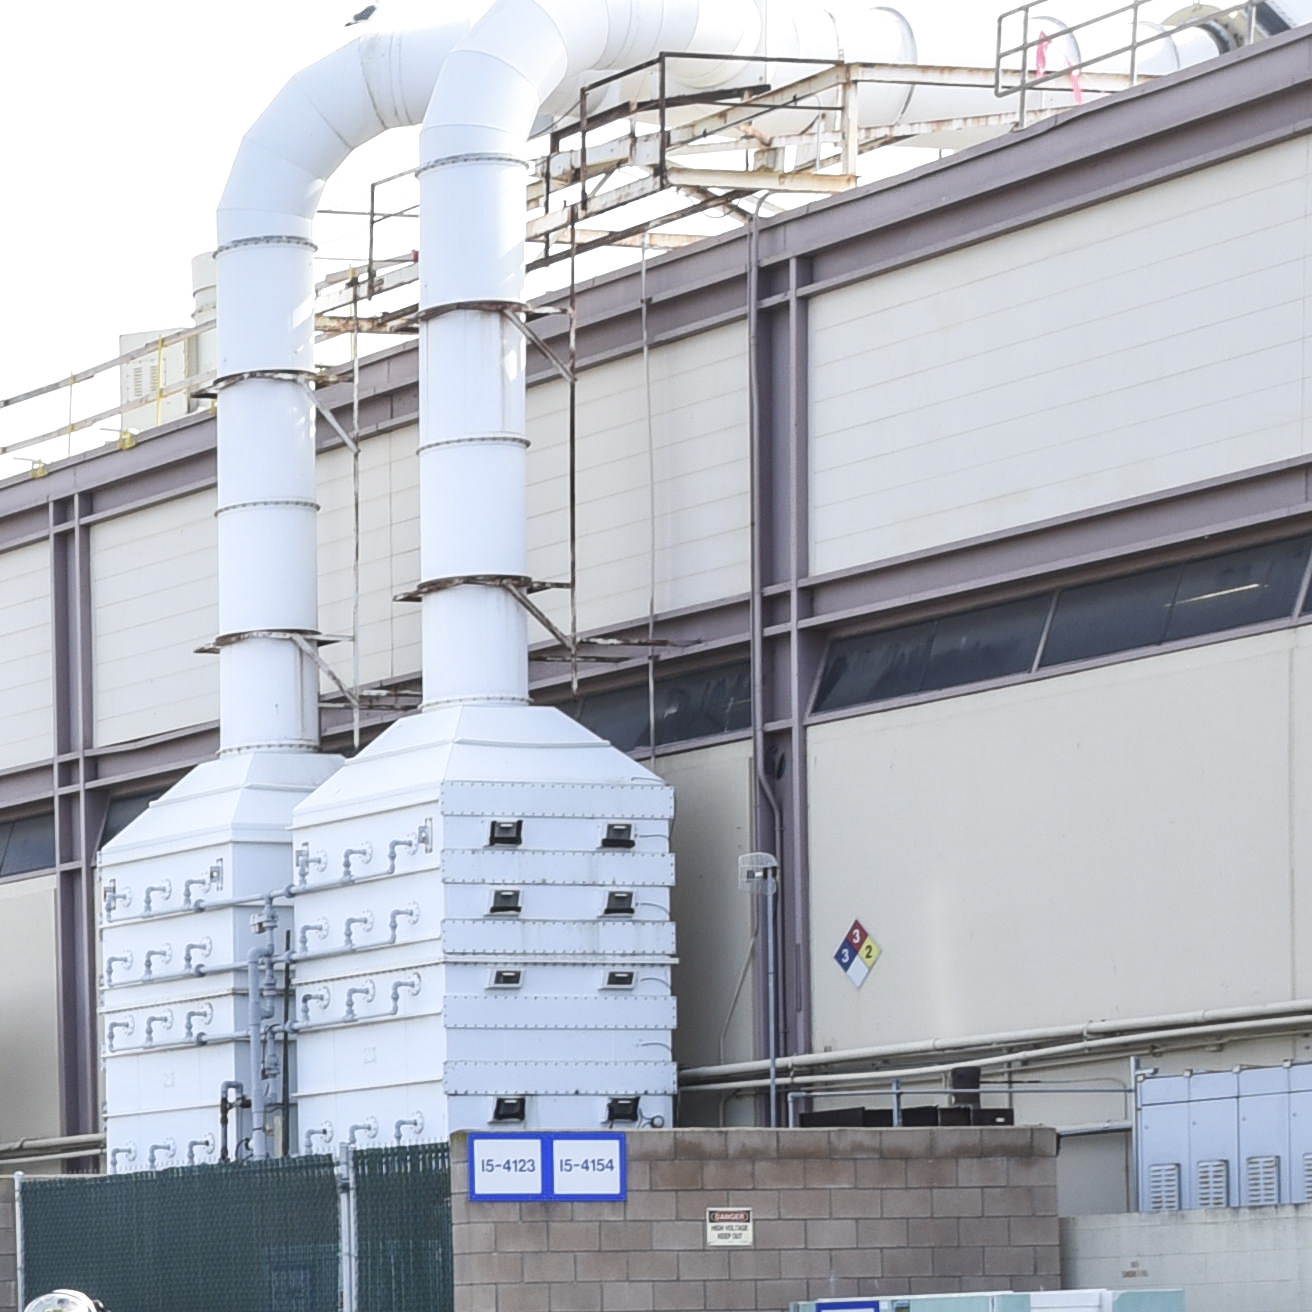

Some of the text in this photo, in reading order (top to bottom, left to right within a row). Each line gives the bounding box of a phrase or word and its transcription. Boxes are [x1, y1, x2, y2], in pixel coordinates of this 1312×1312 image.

[852, 929, 861, 944] 3
[841, 945, 873, 963] 3 2
